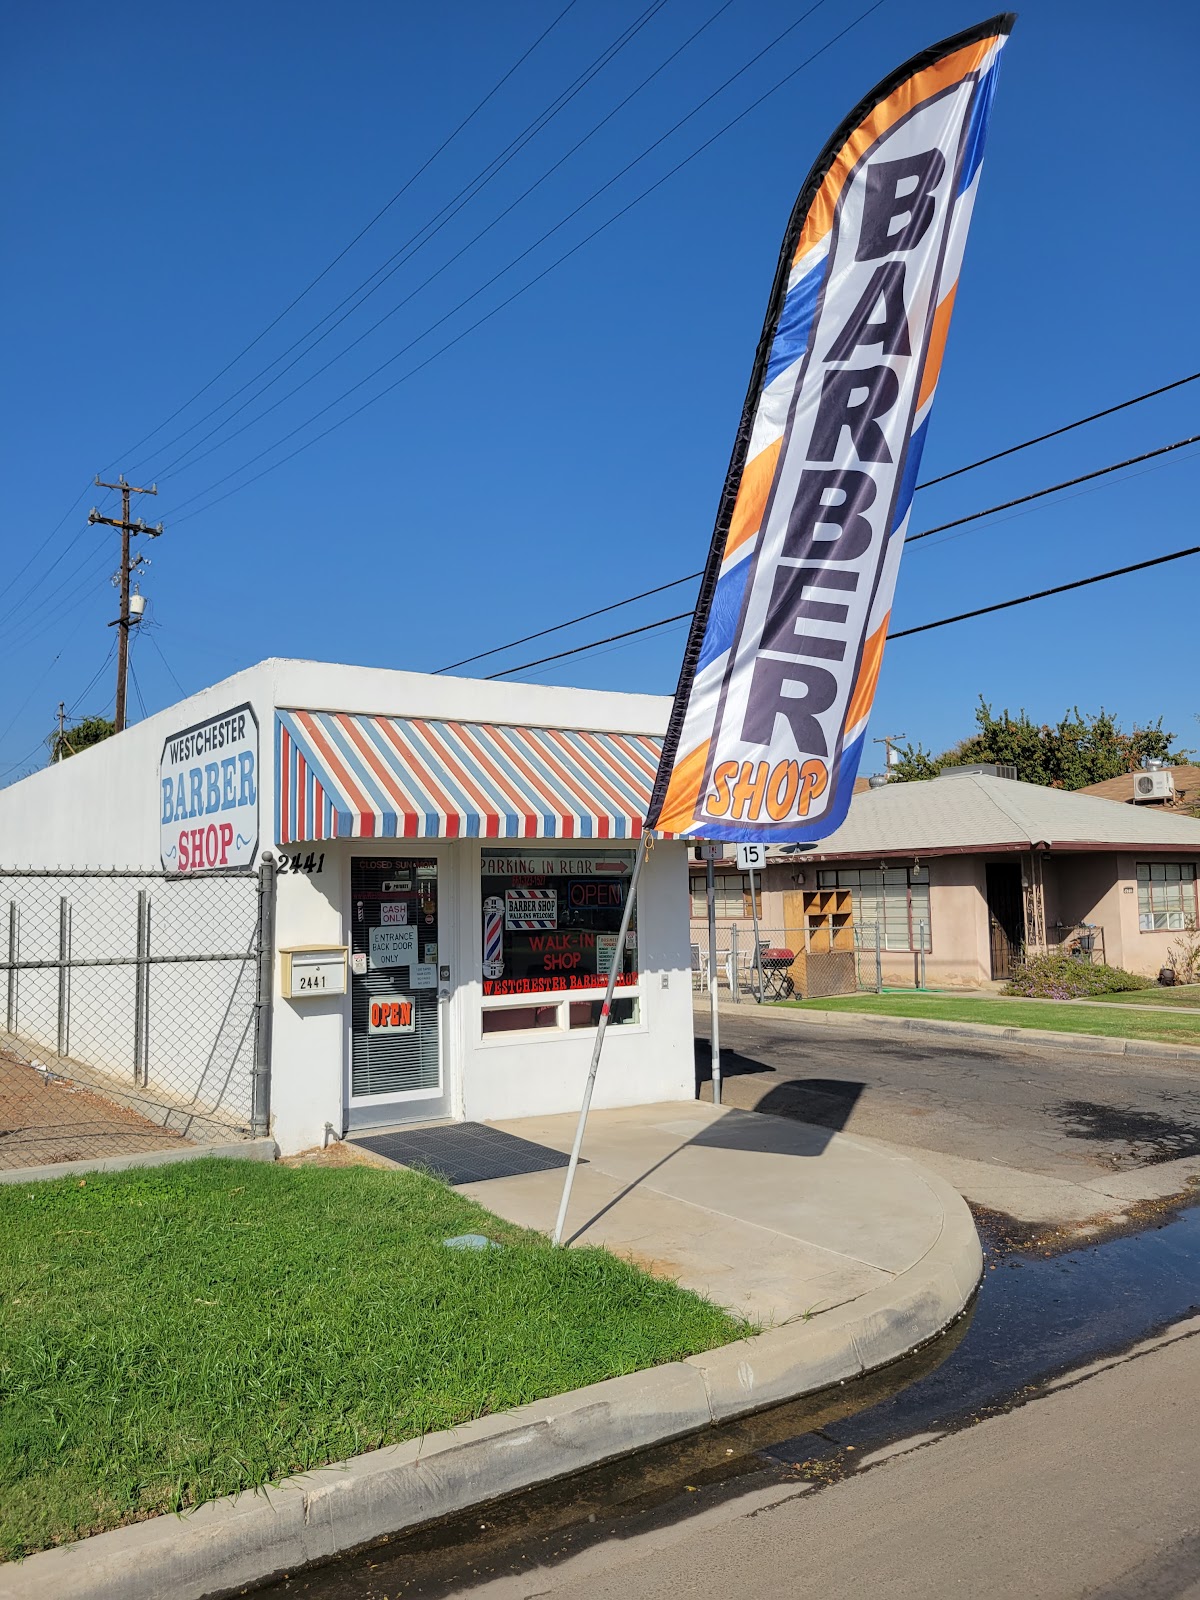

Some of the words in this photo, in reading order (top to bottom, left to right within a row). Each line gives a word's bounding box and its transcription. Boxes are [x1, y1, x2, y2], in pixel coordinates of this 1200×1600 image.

[741, 147, 945, 757] BARBER
[170, 714, 246, 765] WESTCHESTER
[161, 750, 257, 825] BARBER
[706, 758, 829, 821] SHOP
[178, 822, 234, 871] SHOP
[743, 846, 759, 863] 15
[275, 852, 325, 875] 2441
[360, 861, 392, 869] CLOSED
[395, 861, 412, 869] SUN
[481, 859, 535, 874] PARKING
[542, 860, 554, 874] IN
[560, 860, 593, 874] REAR
[570, 883, 621, 905] OPEN
[382, 905, 405, 913] CASH
[508, 900, 536, 912] BARBER
[537, 900, 555, 912] SHOP
[383, 914, 406, 922] ONLY
[374, 932, 414, 942] ENTRANCE
[529, 933, 594, 951] WALK-IN
[372, 943, 390, 951] BACK
[393, 942, 412, 950] DOOR
[381, 954, 398, 963] ONLY
[543, 952, 581, 971] SHOP
[300, 976, 326, 990] 2441
[483, 975, 567, 996] WESTCHESTER
[371, 1002, 413, 1028] OPEN
